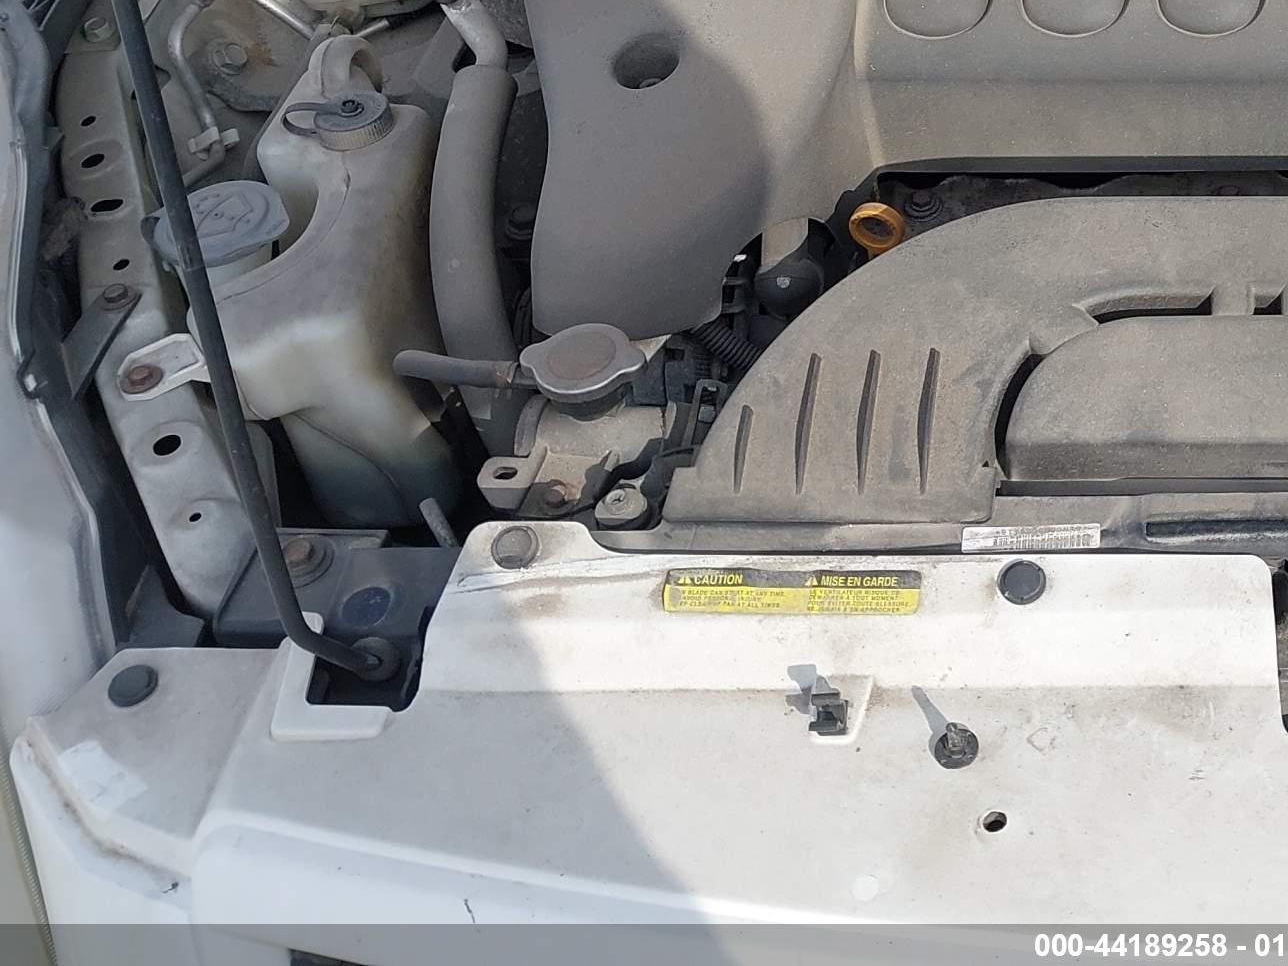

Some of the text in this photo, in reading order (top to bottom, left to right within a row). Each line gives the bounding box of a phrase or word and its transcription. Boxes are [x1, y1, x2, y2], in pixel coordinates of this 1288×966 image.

[694, 575, 743, 585] CAUTION
[820, 576, 899, 587] MISE EN GARDE
